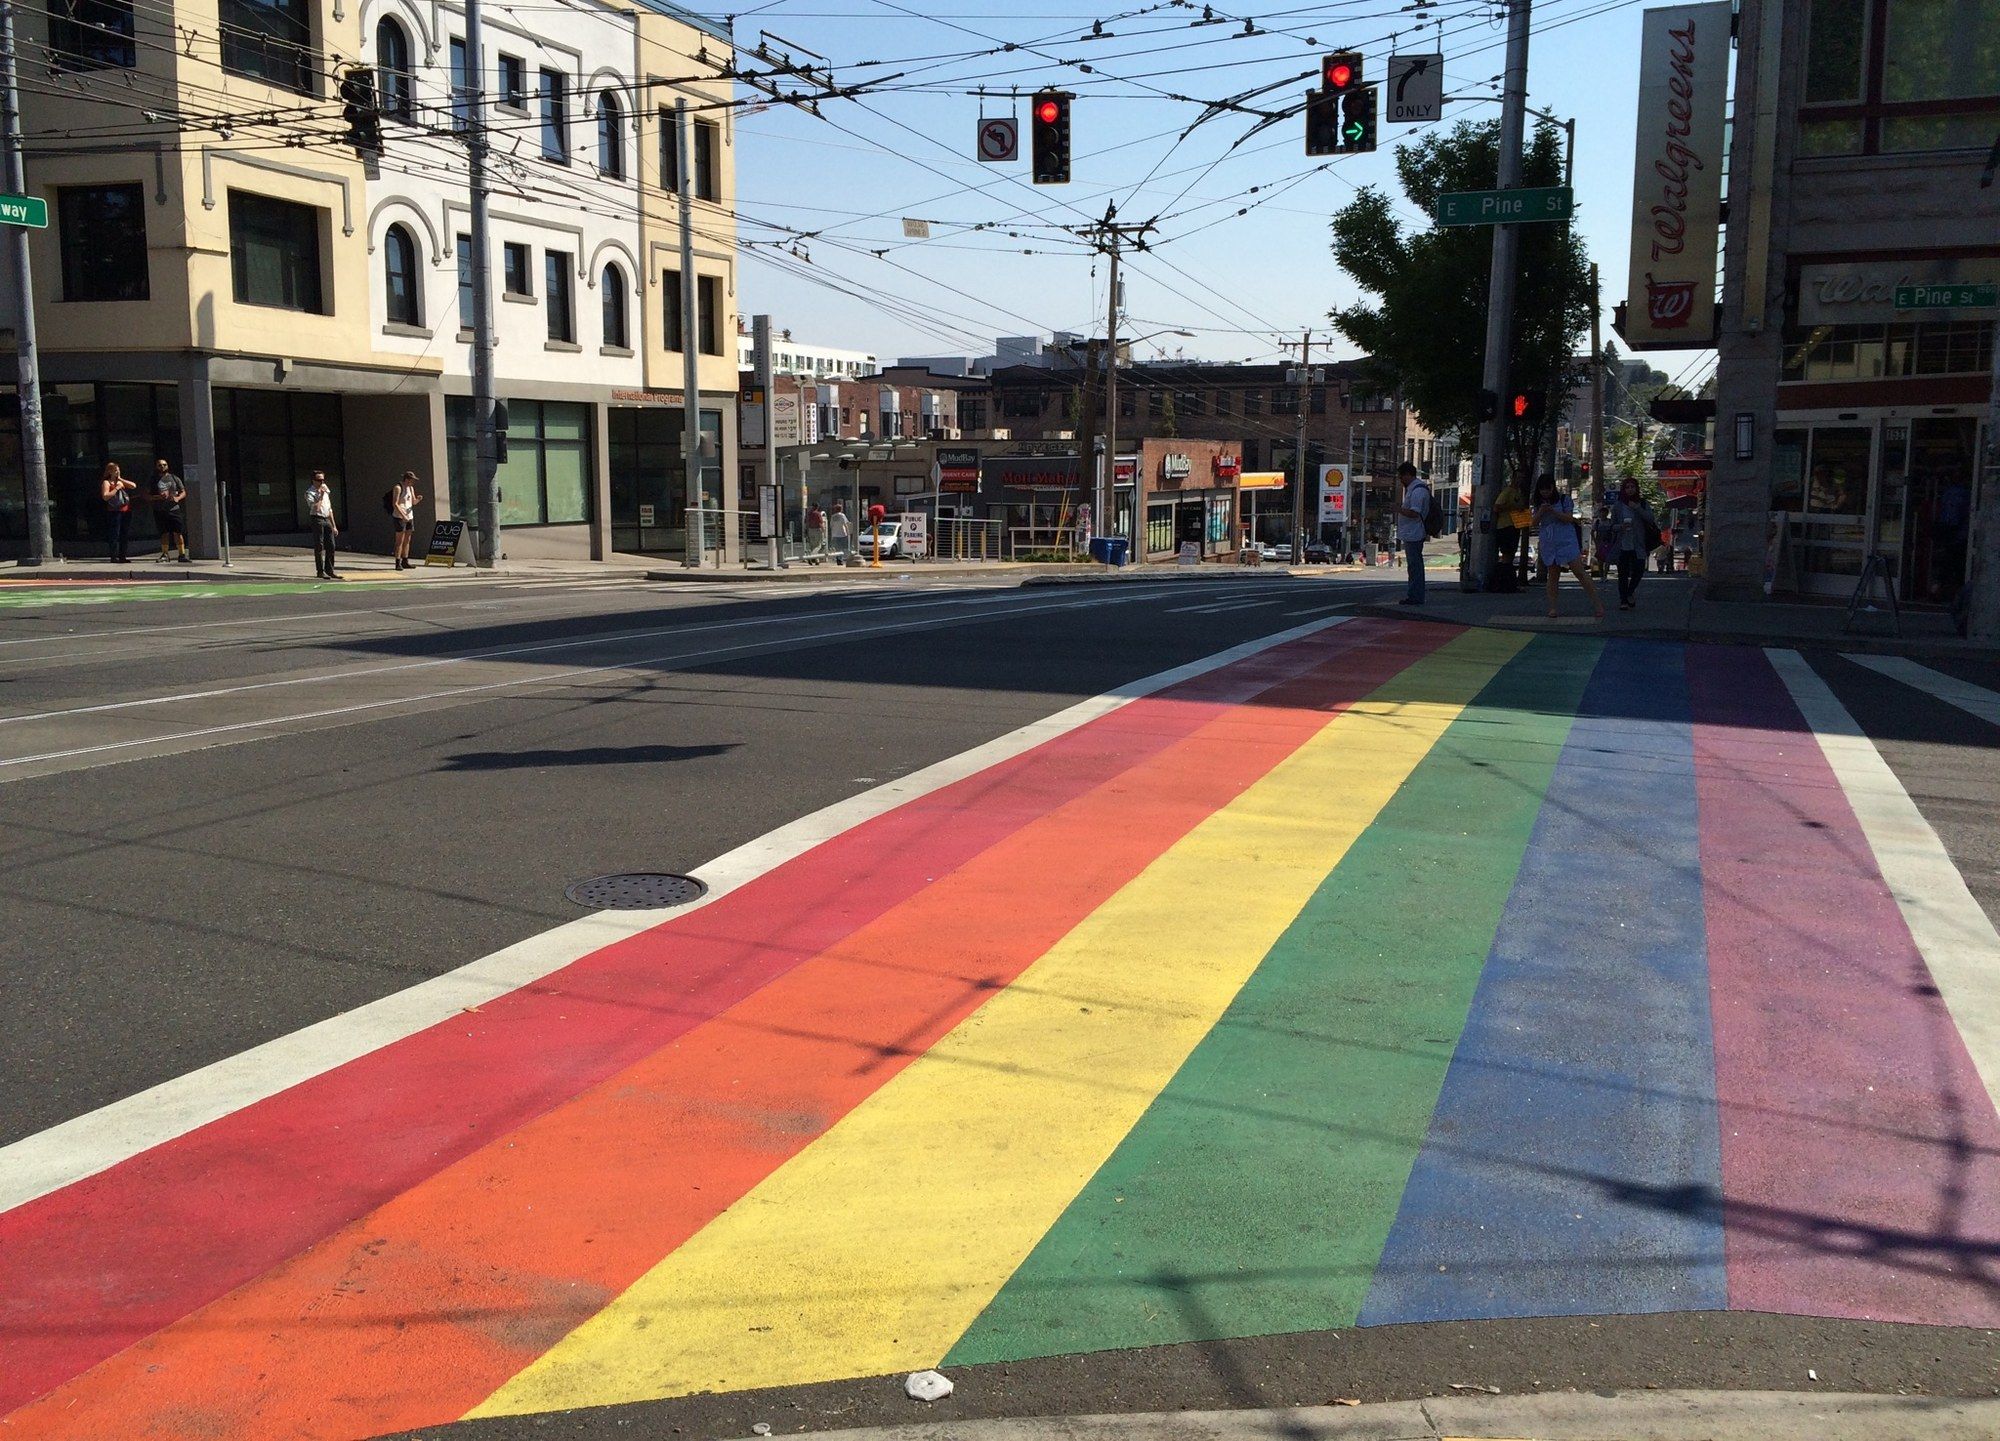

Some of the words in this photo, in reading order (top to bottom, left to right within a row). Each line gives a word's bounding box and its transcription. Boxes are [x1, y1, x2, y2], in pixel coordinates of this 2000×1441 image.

[1395, 105, 1433, 118] ONLY
[1651, 18, 1704, 262] Walgreens
[1446, 202, 1457, 217] E
[1481, 197, 1523, 215] Pine
[1545, 196, 1563, 211] St
[1898, 292, 1909, 306] E
[1914, 286, 1954, 305] Pine
[1960, 290, 1974, 304] St
[947, 453, 976, 463] MudBay
[435, 524, 461, 536] cue
